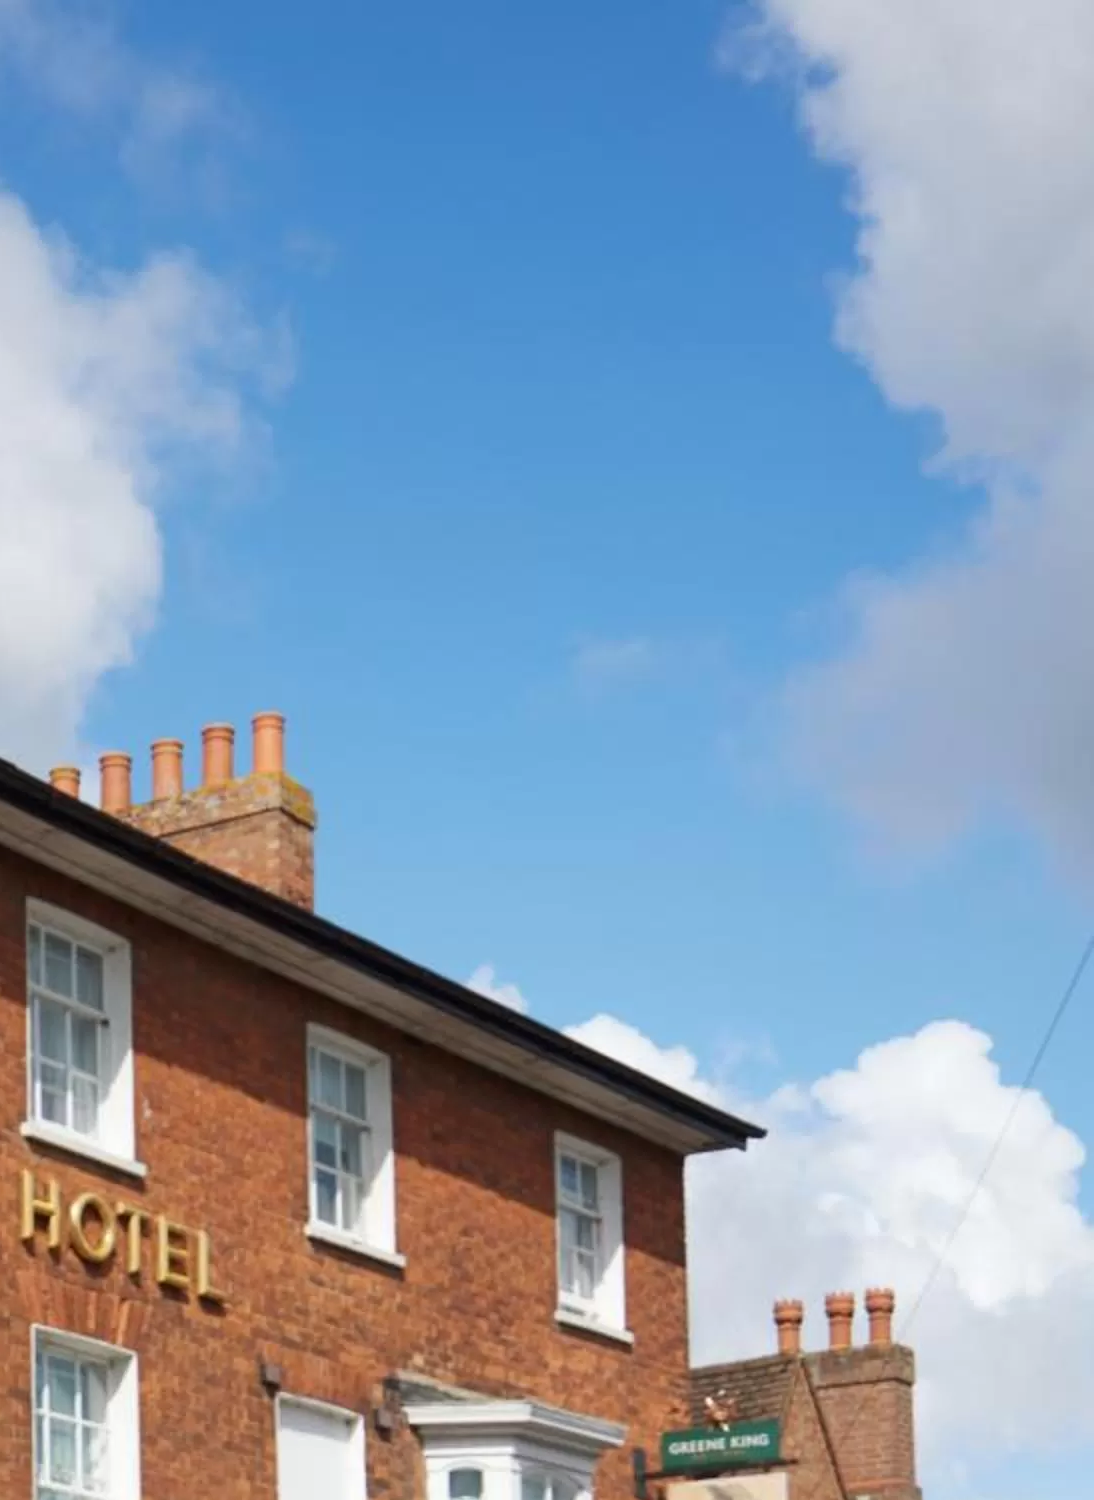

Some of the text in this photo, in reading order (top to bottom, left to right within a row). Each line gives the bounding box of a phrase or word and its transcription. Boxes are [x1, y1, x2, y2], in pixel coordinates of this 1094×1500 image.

[20, 1168, 225, 1298] HOTEL
[668, 1433, 770, 1456] GREENE KING
